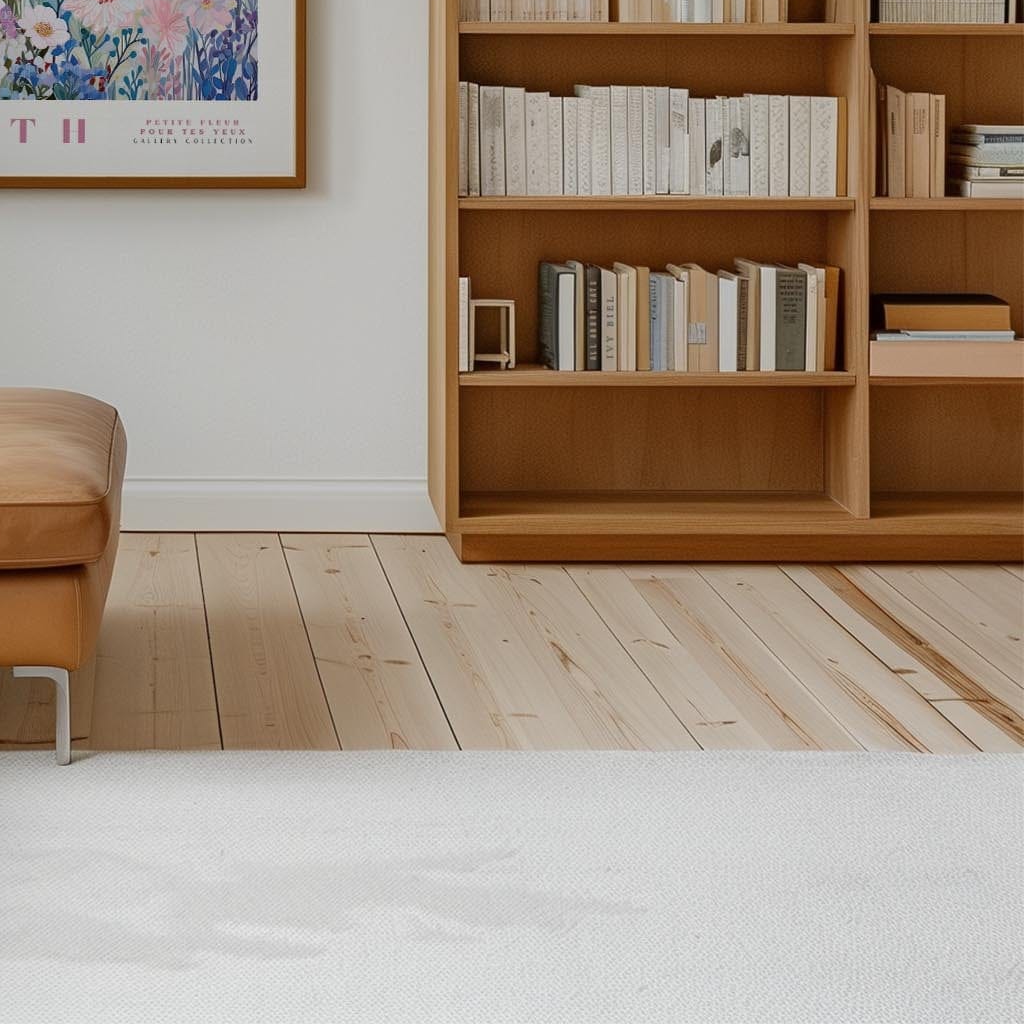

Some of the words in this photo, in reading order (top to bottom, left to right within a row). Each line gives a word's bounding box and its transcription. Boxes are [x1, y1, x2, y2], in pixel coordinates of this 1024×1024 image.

[589, 280, 598, 304] CATS
[589, 309, 598, 338] ABOUT
[606, 296, 614, 327] BIEL
[589, 343, 597, 361] ALL
[606, 335, 614, 360] IVY
